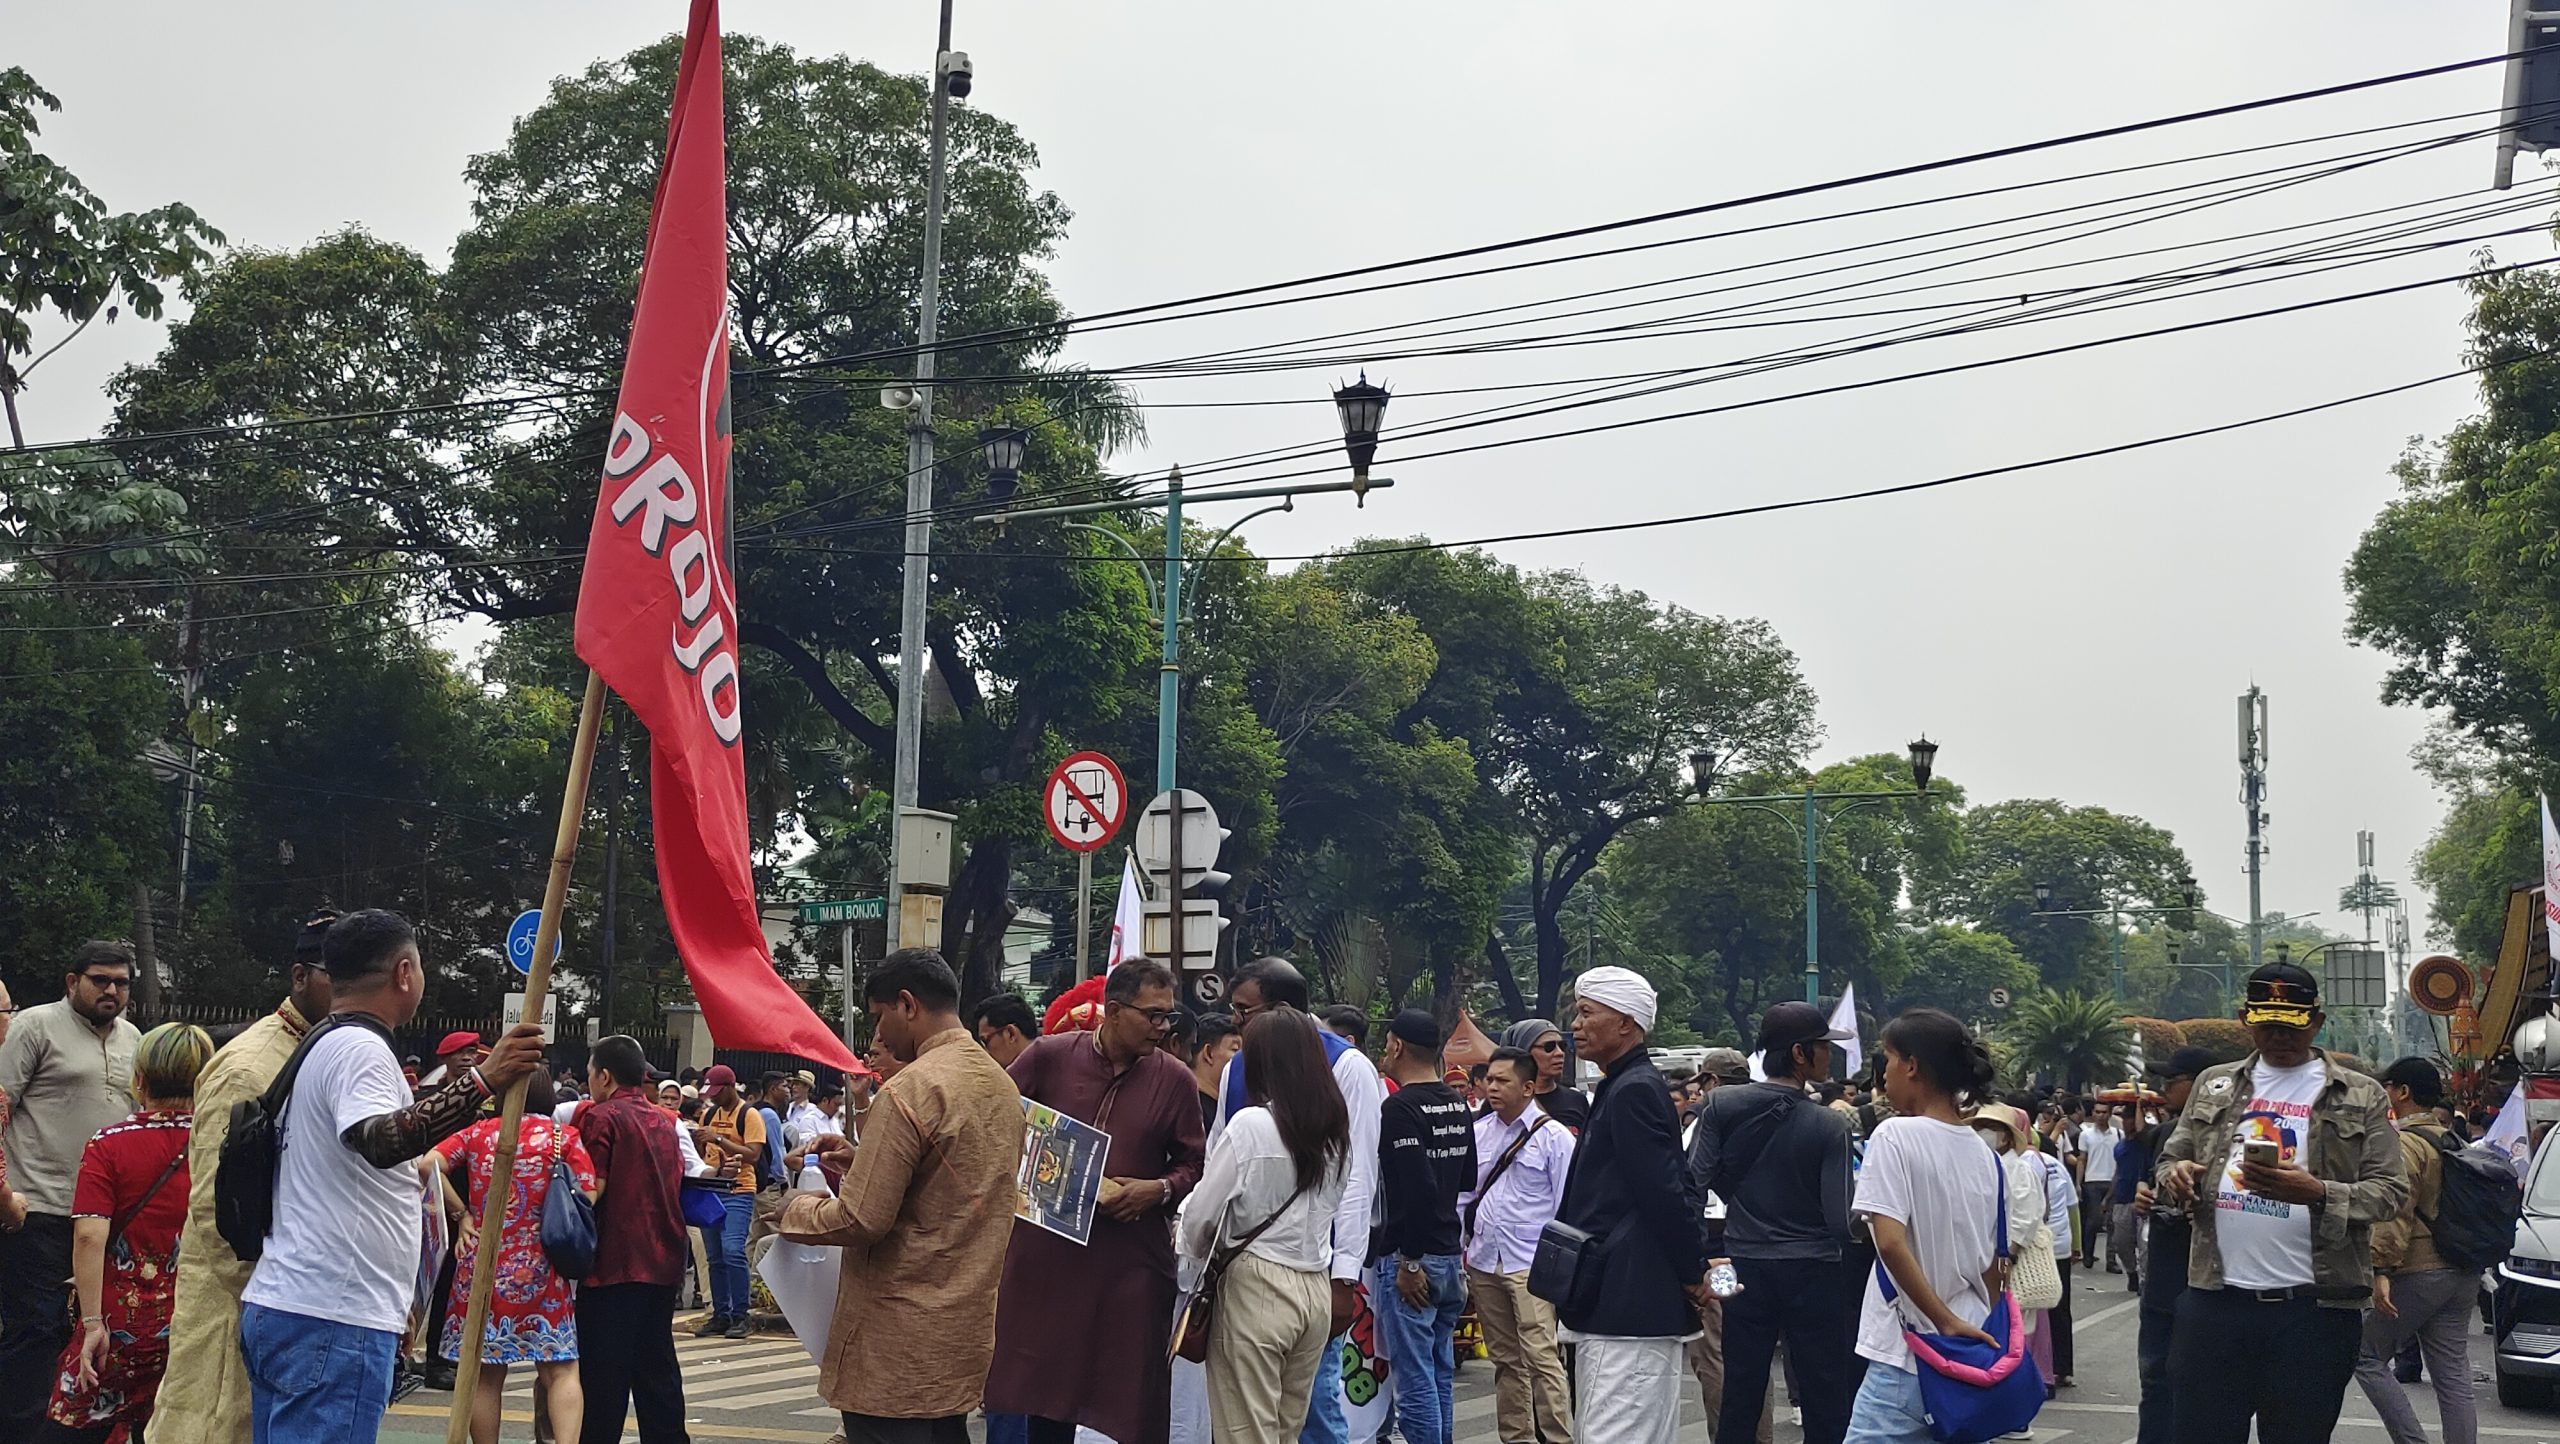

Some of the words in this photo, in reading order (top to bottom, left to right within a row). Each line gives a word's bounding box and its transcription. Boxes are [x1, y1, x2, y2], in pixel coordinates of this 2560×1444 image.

[604, 410, 742, 748] PROJO
[820, 906, 843, 921] IMAM
[846, 902, 882, 919] BONJOL
